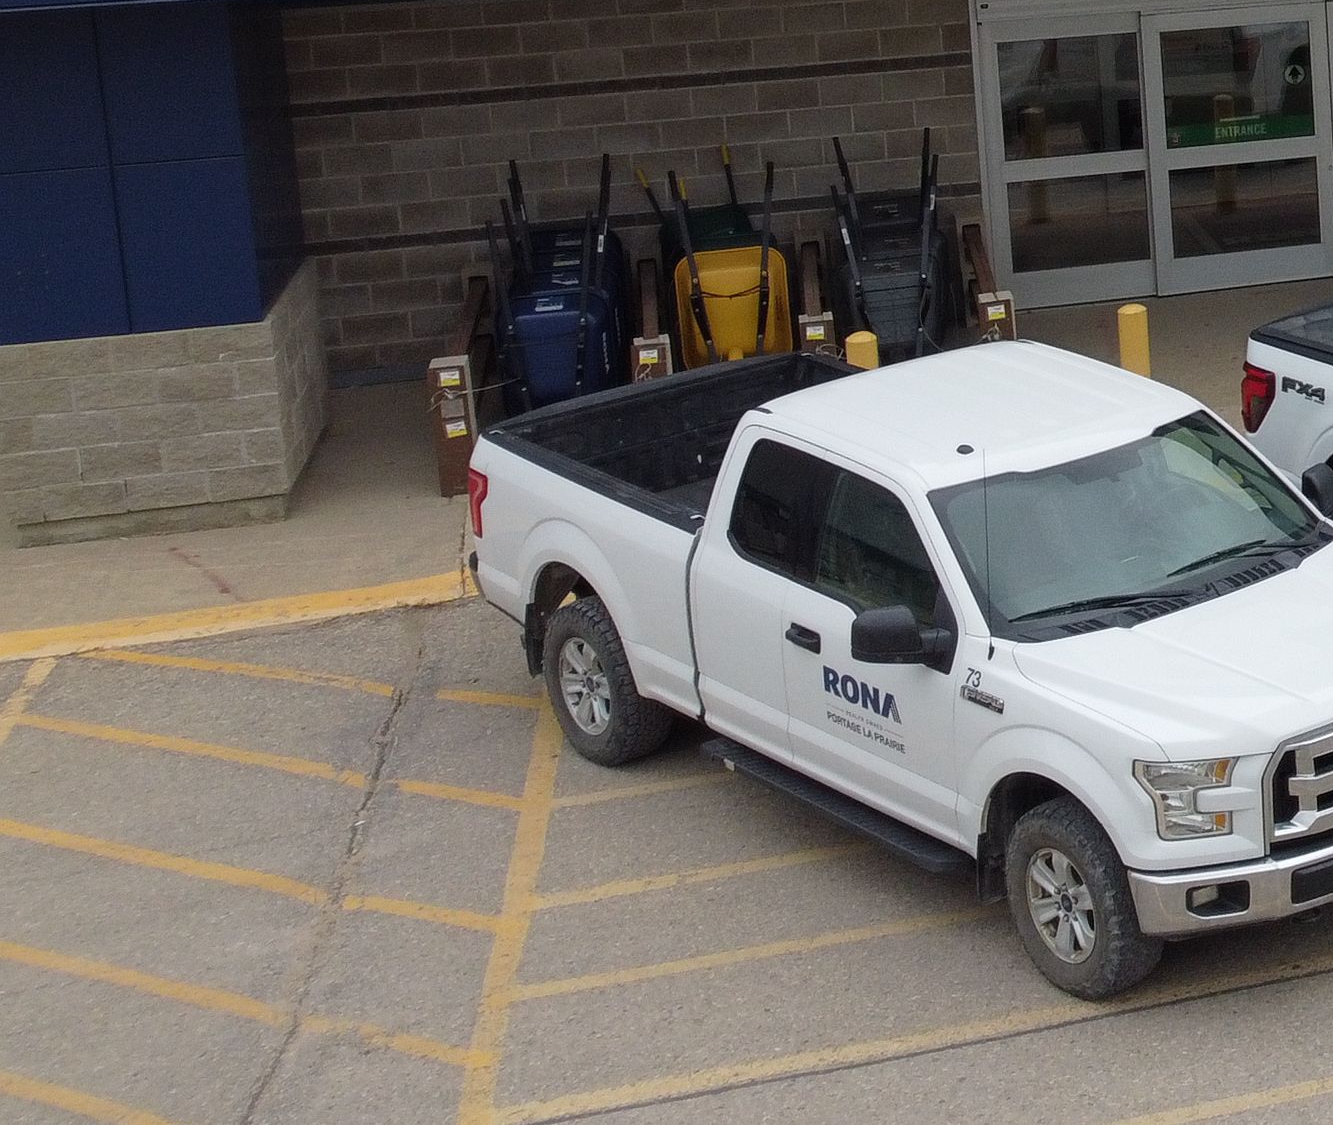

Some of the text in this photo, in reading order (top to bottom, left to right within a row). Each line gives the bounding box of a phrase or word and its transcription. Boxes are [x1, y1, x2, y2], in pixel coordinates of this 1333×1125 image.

[1215, 123, 1267, 139] ENTRANCE
[1281, 376, 1326, 402] FX4
[965, 667, 982, 688] 73
[823, 665, 902, 725] RONA
[826, 710, 906, 755] PORTAGE LA PRAIRIE
